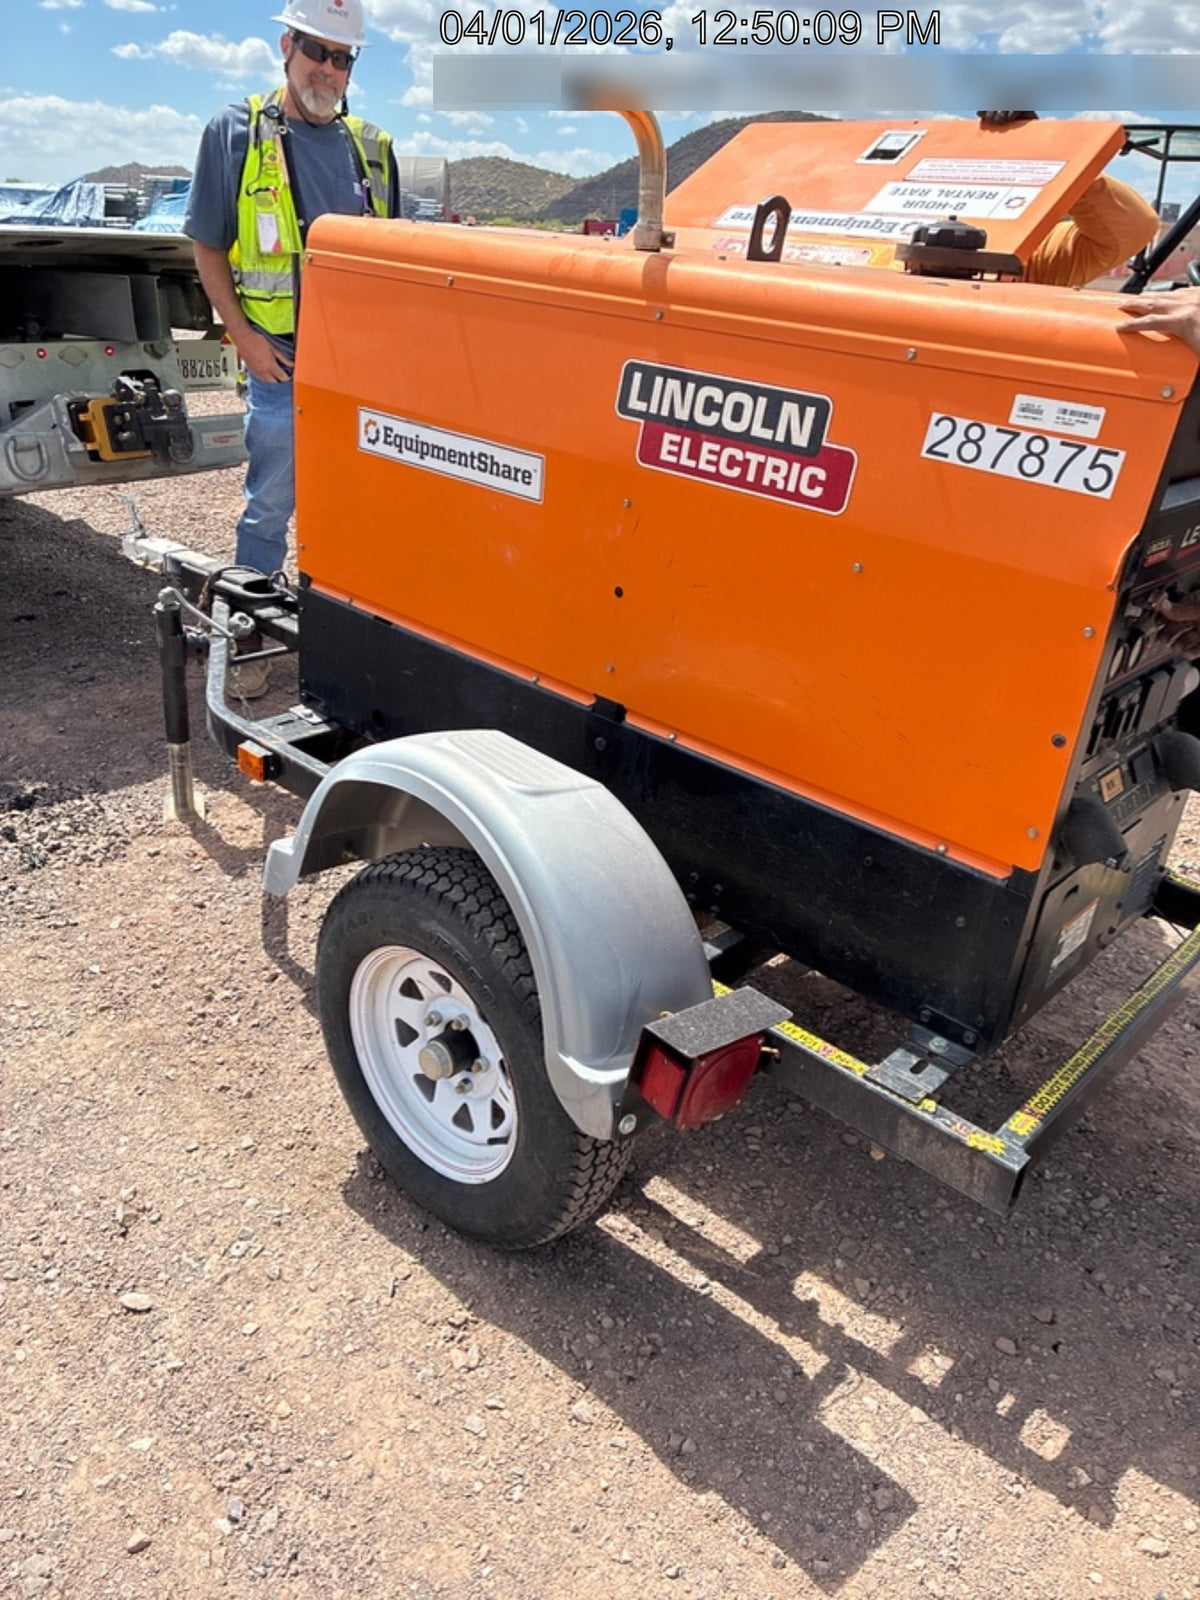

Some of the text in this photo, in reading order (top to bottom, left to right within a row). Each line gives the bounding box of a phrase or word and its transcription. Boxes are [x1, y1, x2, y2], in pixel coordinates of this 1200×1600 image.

[627, 371, 817, 448] LINCOLN
[382, 425, 533, 486] EquipmentShare
[659, 431, 827, 498] ELECTRIC
[926, 416, 1120, 493] 287875
